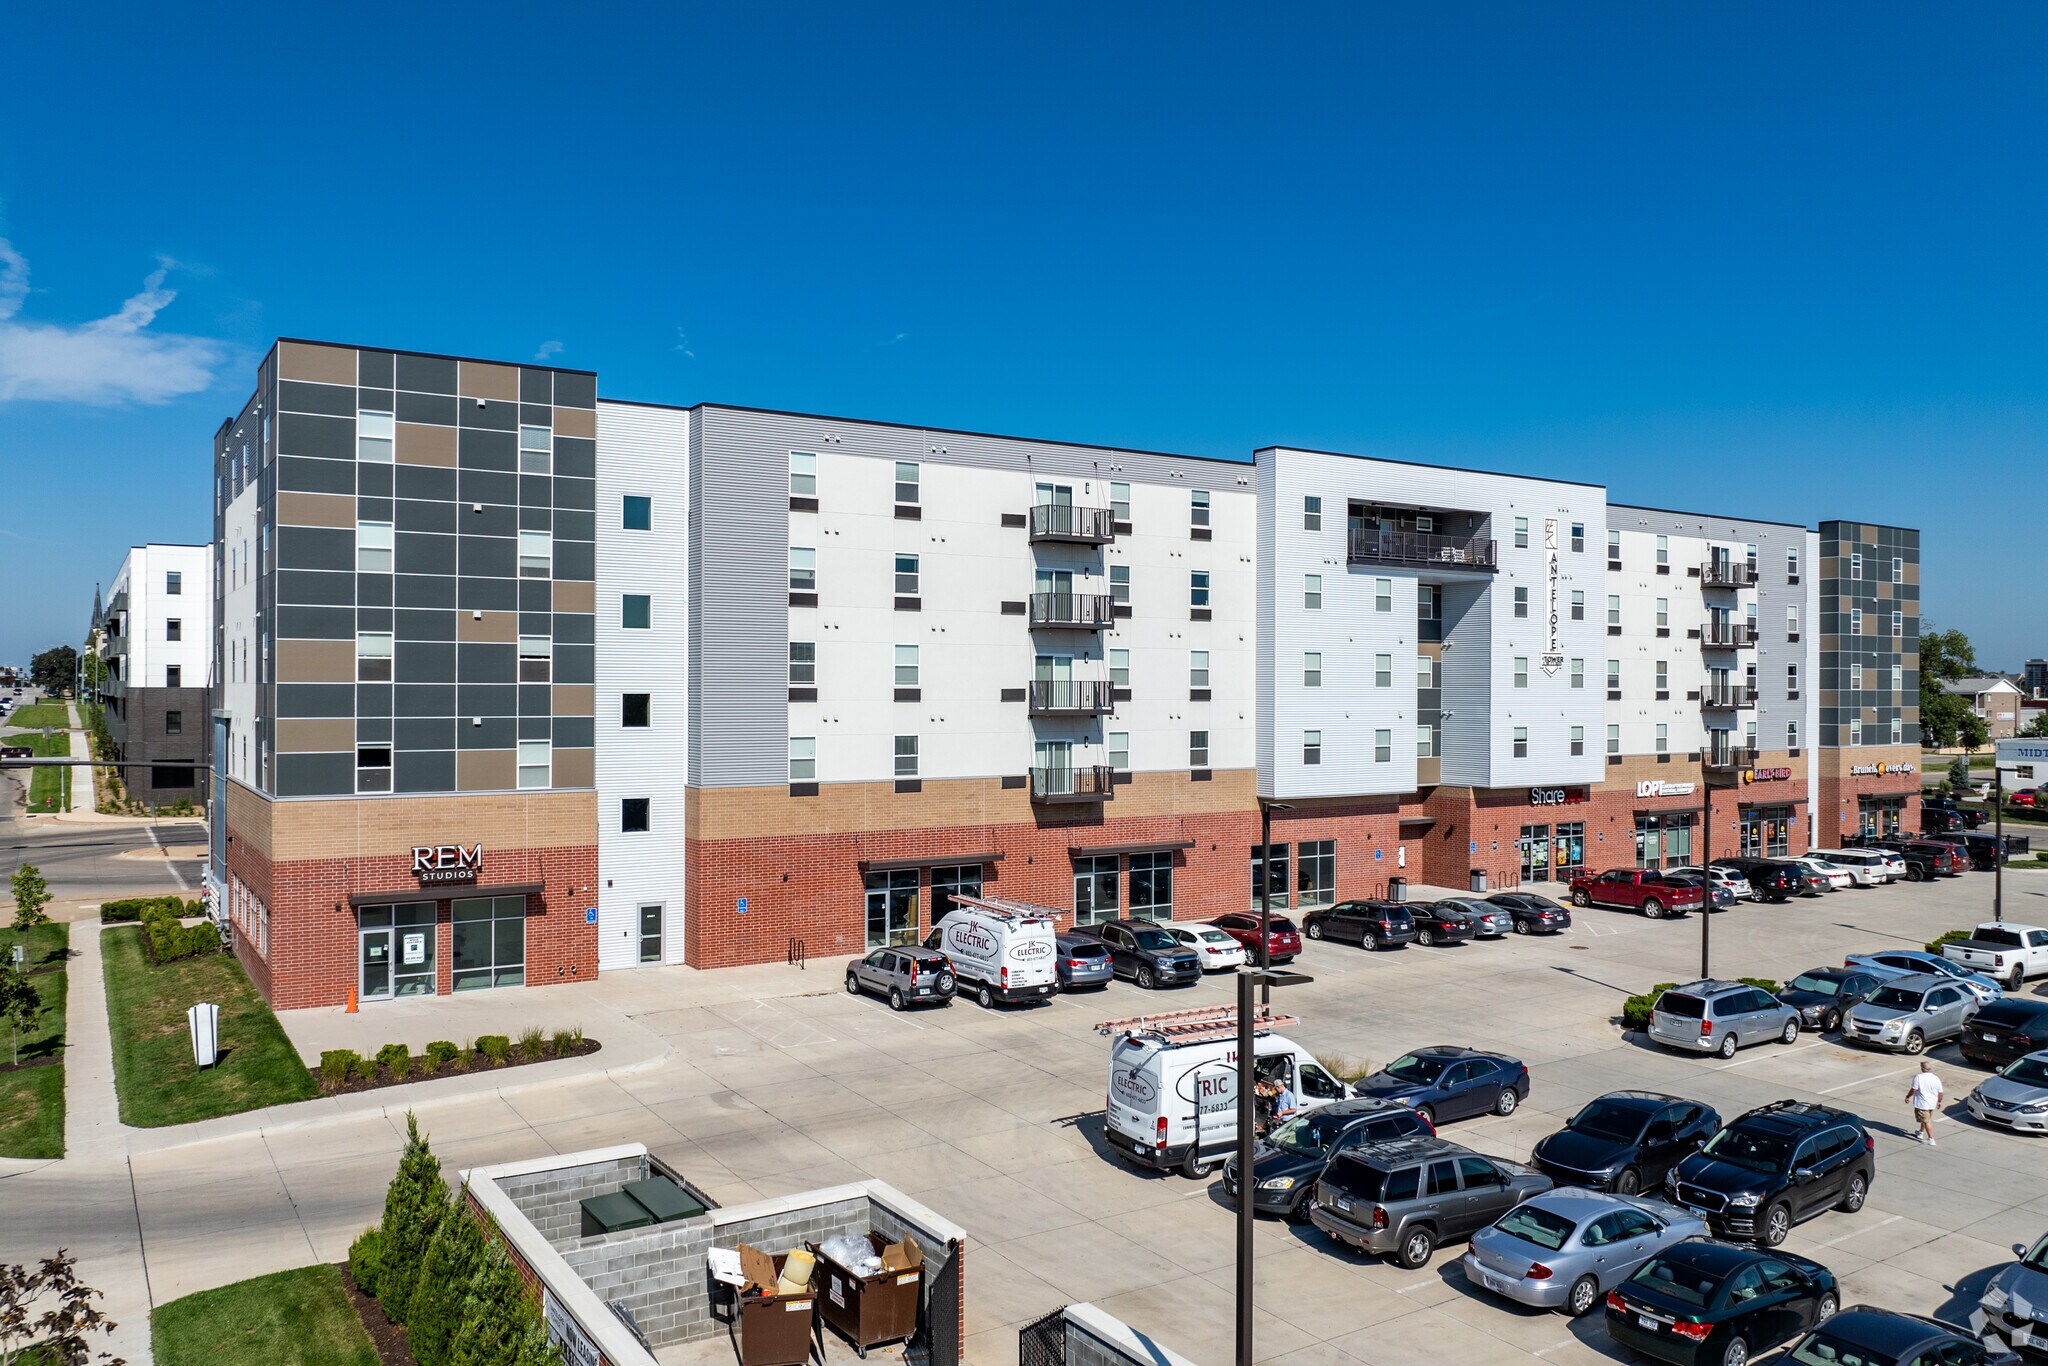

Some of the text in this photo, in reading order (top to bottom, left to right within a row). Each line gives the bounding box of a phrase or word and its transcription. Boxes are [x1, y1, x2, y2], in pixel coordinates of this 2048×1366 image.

[1550, 552, 1558, 649] ANTELOPE
[2018, 748, 2048, 757] MIDT
[1754, 768, 1791, 779] EARLY BIRD
[1853, 764, 1878, 774] Brunch
[1636, 780, 1665, 797] LOPT
[411, 843, 482, 870] REM
[422, 870, 473, 881] STUDIOS
[969, 920, 978, 933] JK
[955, 931, 990, 950] ELECTRIC
[1028, 940, 1036, 948] JK
[1017, 946, 1046, 956] ELECTRIC
[1117, 1076, 1147, 1095] ELECTRIC
[1200, 1102, 1228, 1115] 77-6833
